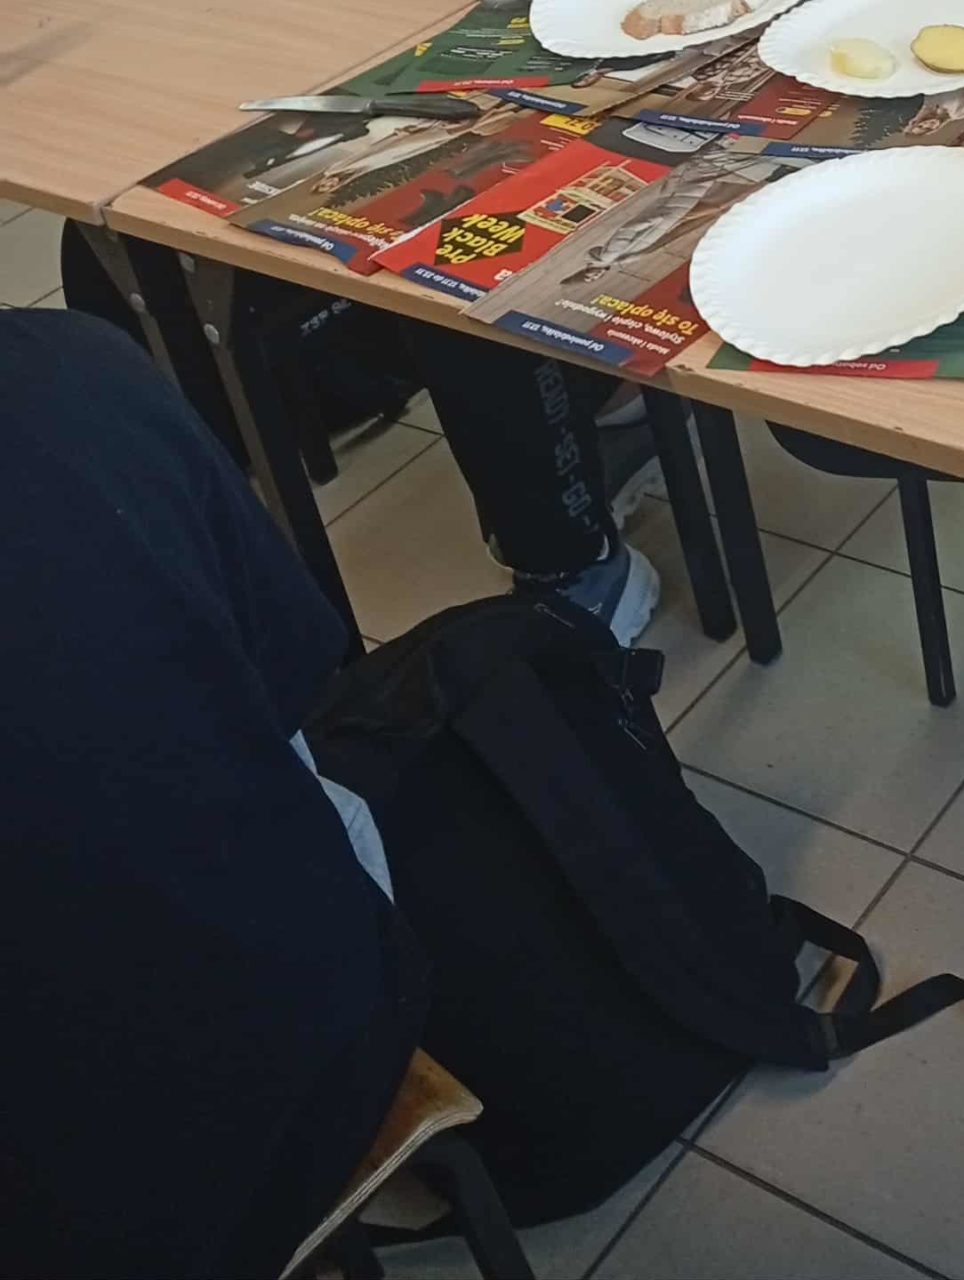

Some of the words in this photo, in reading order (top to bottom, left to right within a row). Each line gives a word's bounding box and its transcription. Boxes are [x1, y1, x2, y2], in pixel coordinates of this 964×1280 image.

[462, 214, 526, 241] Week
[442, 227, 509, 256] Black
[436, 244, 477, 264] Pre
[652, 309, 678, 326] się
[678, 322, 699, 335] To
